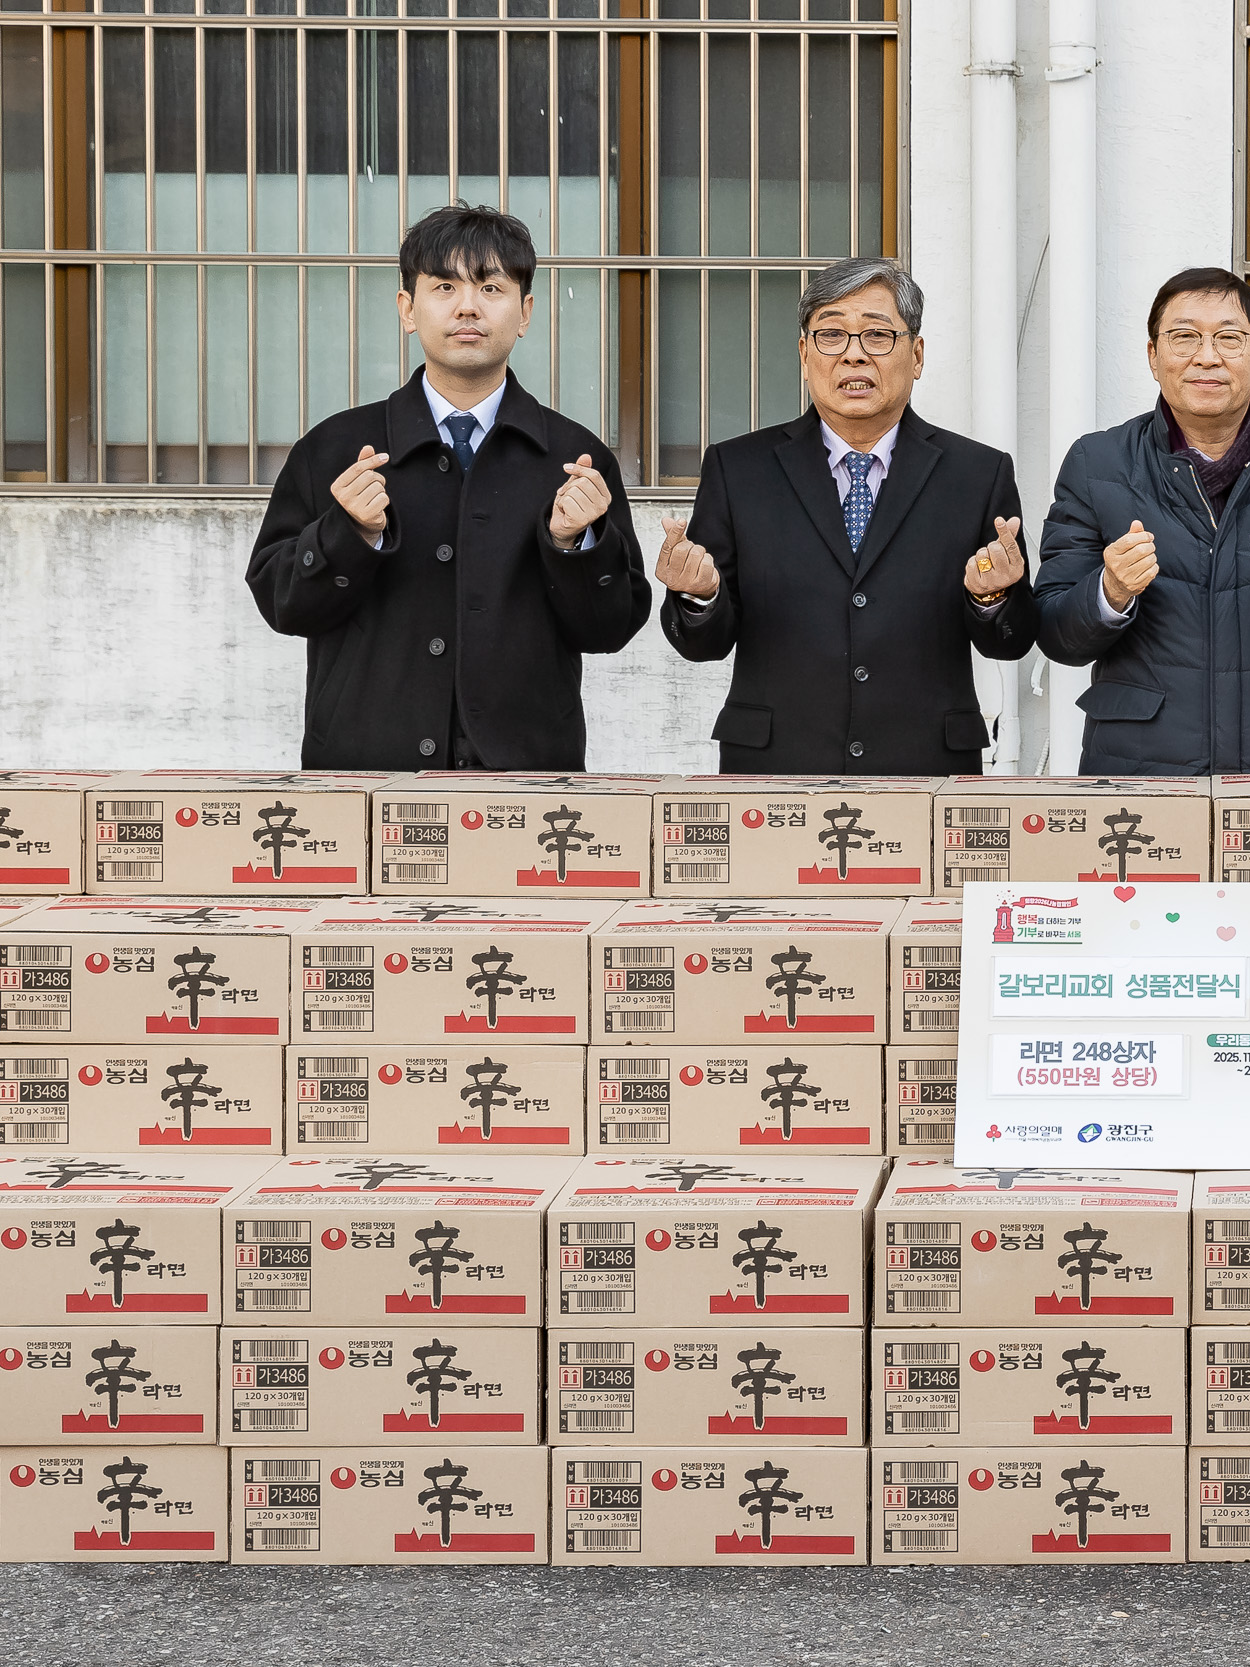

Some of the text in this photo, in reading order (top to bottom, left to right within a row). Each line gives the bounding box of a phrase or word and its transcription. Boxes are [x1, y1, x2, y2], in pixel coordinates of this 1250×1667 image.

[202, 811, 240, 826] 농심
[767, 812, 806, 827] 농심
[1048, 817, 1086, 832] 농심
[120, 826, 160, 840] 가3486
[253, 801, 337, 877] 辛 라면
[405, 828, 445, 842] 가3486
[819, 802, 876, 878] 辛
[587, 844, 622, 858] 라면
[1147, 846, 1182, 860] 라면
[1017, 914, 1081, 925] 행복을 더하는 기부
[1017, 927, 1081, 938] 기부로 바꾸는 서울
[113, 956, 154, 973] 농심
[711, 956, 752, 972] 농심
[168, 946, 230, 1028] 辛
[328, 972, 372, 987] 가3486
[629, 973, 672, 988] 가3486
[766, 946, 854, 1025] 辛 라면
[998, 973, 1240, 999] 갈보리교회 성품전달식
[519, 987, 557, 1003] 라면
[1020, 1041, 1157, 1064] 라면 248상자
[106, 1067, 147, 1084] 농심
[707, 1068, 747, 1084] 농심
[1017, 1066, 1158, 1087] (550만원 상당)
[161, 1057, 222, 1138] 辛
[323, 1083, 367, 1098] 가3486
[761, 1057, 822, 1138] 辛
[513, 1098, 550, 1113] 라면
[1005, 1125, 1062, 1137] 사랑의열매
[1107, 1124, 1154, 1136] 광진구
[31, 1230, 75, 1248] 농심
[674, 1232, 718, 1249] 농심
[90, 1218, 156, 1305] 辛
[262, 1248, 308, 1264] 가3486
[733, 1220, 798, 1306] 辛
[913, 1250, 959, 1266] 가3486
[465, 1264, 505, 1281] 라면
[1114, 1266, 1153, 1282] 라면
[26, 1350, 71, 1368] 농심
[674, 1353, 717, 1370] 농심
[86, 1339, 151, 1426] 辛
[259, 1368, 305, 1384] 가3486
[911, 1370, 957, 1386] 가3486
[463, 1382, 503, 1399] 라면
[731, 1342, 796, 1428] 辛
[1112, 1385, 1151, 1401] 라면
[39, 1468, 82, 1485] 농심
[681, 1472, 724, 1489] 농심
[997, 1471, 1041, 1488] 농심
[97, 1456, 163, 1543] 辛
[271, 1487, 317, 1503] 가3486
[910, 1489, 956, 1505] 가3486
[1055, 1460, 1150, 1546] 辛 라면
[474, 1502, 514, 1519] 라면
[739, 1461, 804, 1547] 辛
